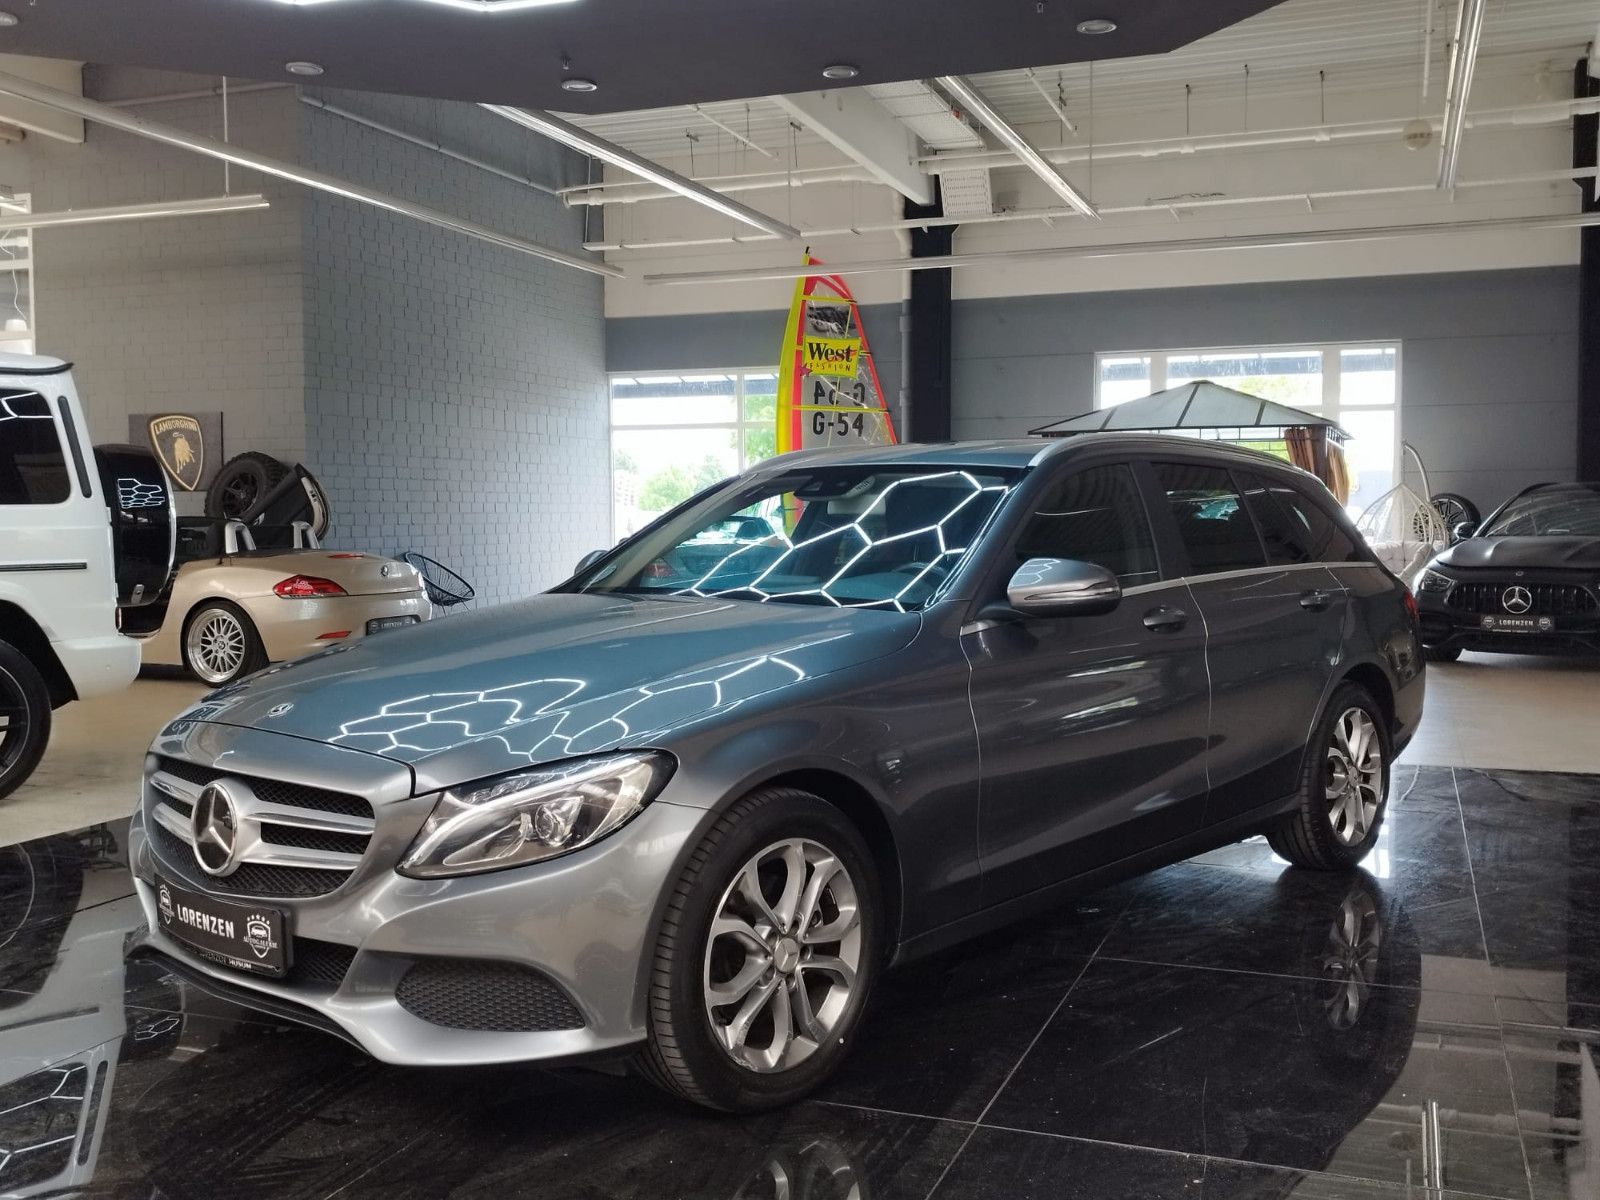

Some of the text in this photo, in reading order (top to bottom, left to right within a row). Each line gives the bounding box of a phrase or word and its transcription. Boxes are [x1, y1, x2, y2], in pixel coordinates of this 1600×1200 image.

[807, 342, 853, 363] West
[154, 419, 198, 435] LAMBORGHINI
[812, 411, 864, 437] G-54
[177, 903, 235, 939] LORENZEN
